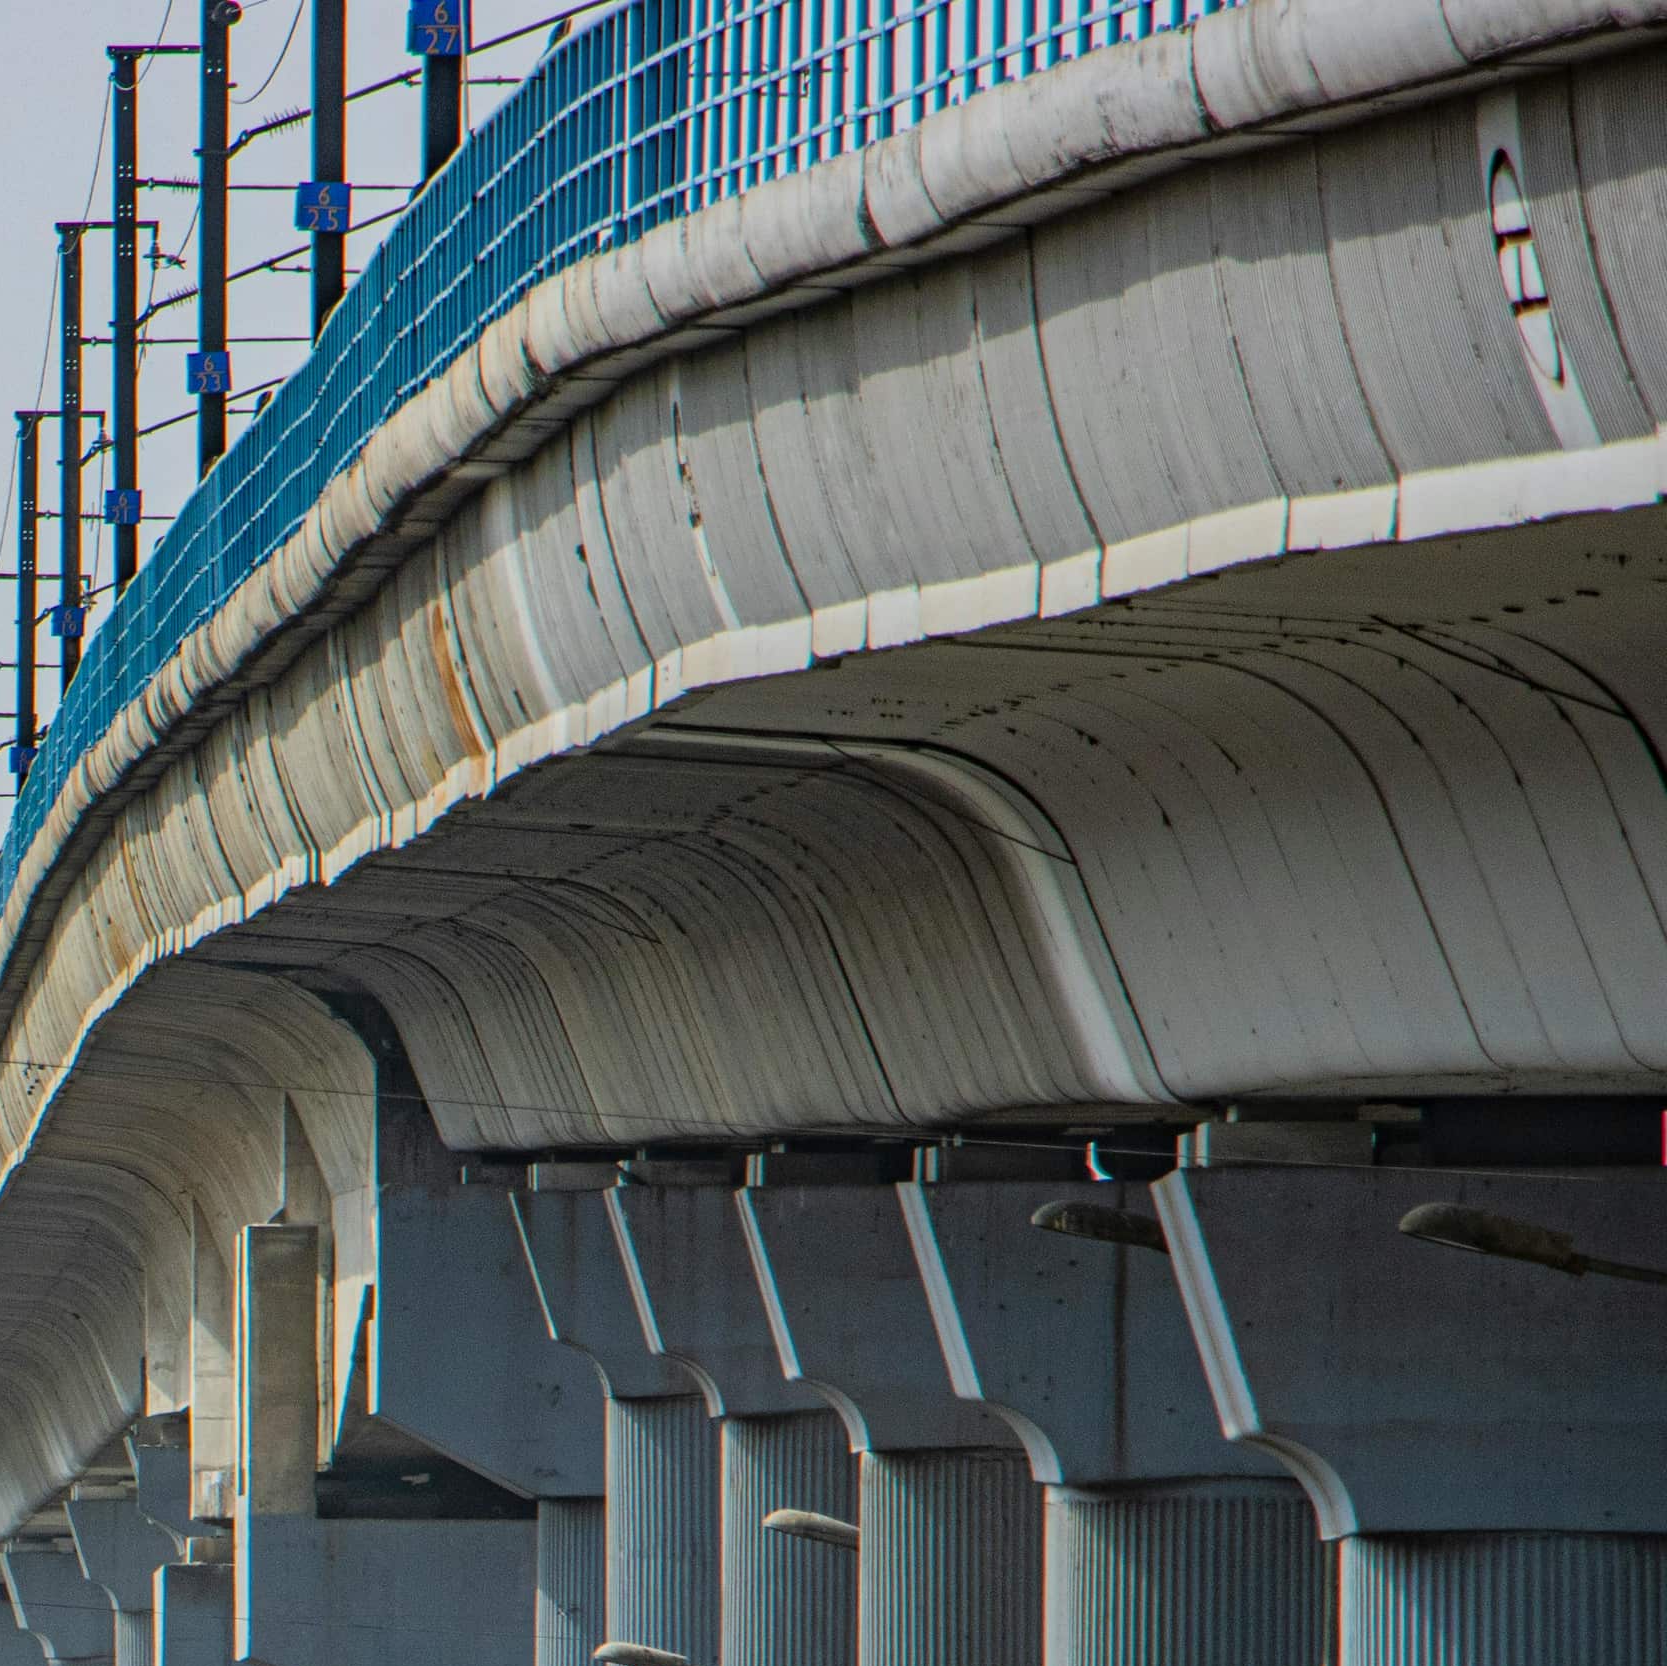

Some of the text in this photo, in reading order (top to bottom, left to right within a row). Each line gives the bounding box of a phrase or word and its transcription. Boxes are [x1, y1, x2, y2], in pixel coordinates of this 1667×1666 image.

[433, 1, 448, 24] 6
[425, 28, 458, 54] 27
[318, 185, 330, 205] 6
[307, 207, 339, 231] 25
[204, 355, 215, 371] 6
[197, 374, 221, 393] 23
